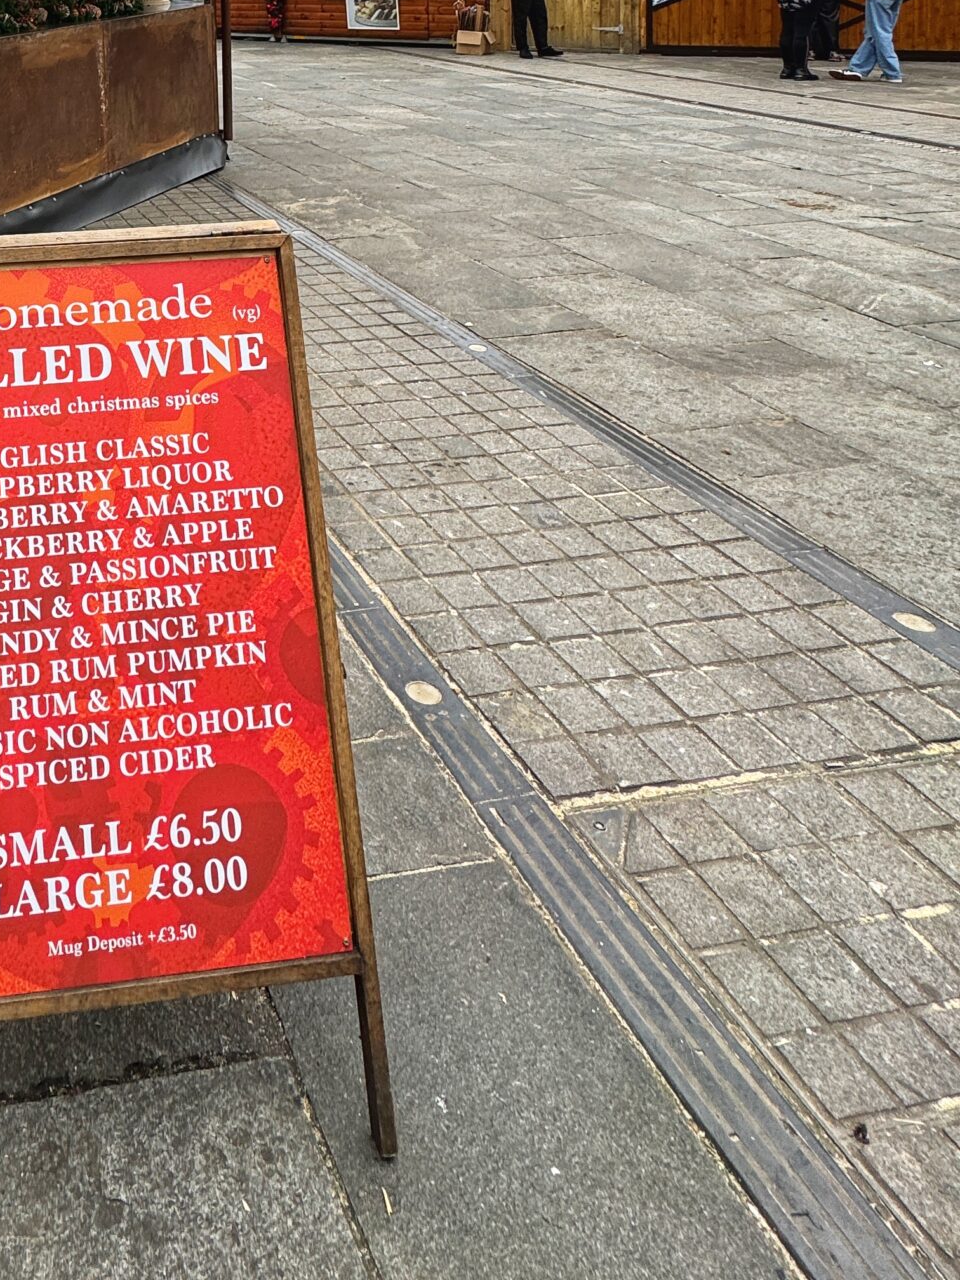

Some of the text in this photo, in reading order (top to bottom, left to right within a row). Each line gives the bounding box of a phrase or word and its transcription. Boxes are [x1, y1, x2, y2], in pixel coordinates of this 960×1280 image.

[232, 304, 261, 323] (vg)
[125, 332, 267, 379] WINE
[3, 397, 61, 419] mixed
[67, 395, 160, 414] christmas
[165, 389, 219, 410] spices
[96, 432, 210, 461] CLASSIC
[122, 460, 234, 491] LIQUOR
[96, 499, 119, 521] &
[125, 485, 284, 519] AMARETTO
[133, 526, 155, 549] &
[162, 517, 254, 546] APPLE
[39, 565, 62, 588] &
[69, 546, 277, 585] PASSIONFRUIT
[51, 595, 74, 619] &
[81, 583, 203, 616] CHERRY
[70, 625, 93, 649] &
[100, 615, 198, 646] MINCE
[206, 610, 256, 636] PIE
[49, 654, 118, 684] RUM
[126, 640, 266, 676] PUMPKIN
[9, 679, 196, 721] RUM & MINT
[44, 721, 110, 751] NON
[118, 703, 293, 743] ALCOHOLIC
[0, 744, 216, 790] SPICED CIDER
[143, 807, 242, 851] £6.50
[146, 855, 248, 901] £8.00
[48, 923, 197, 957] Mug Deposit +£3.50
